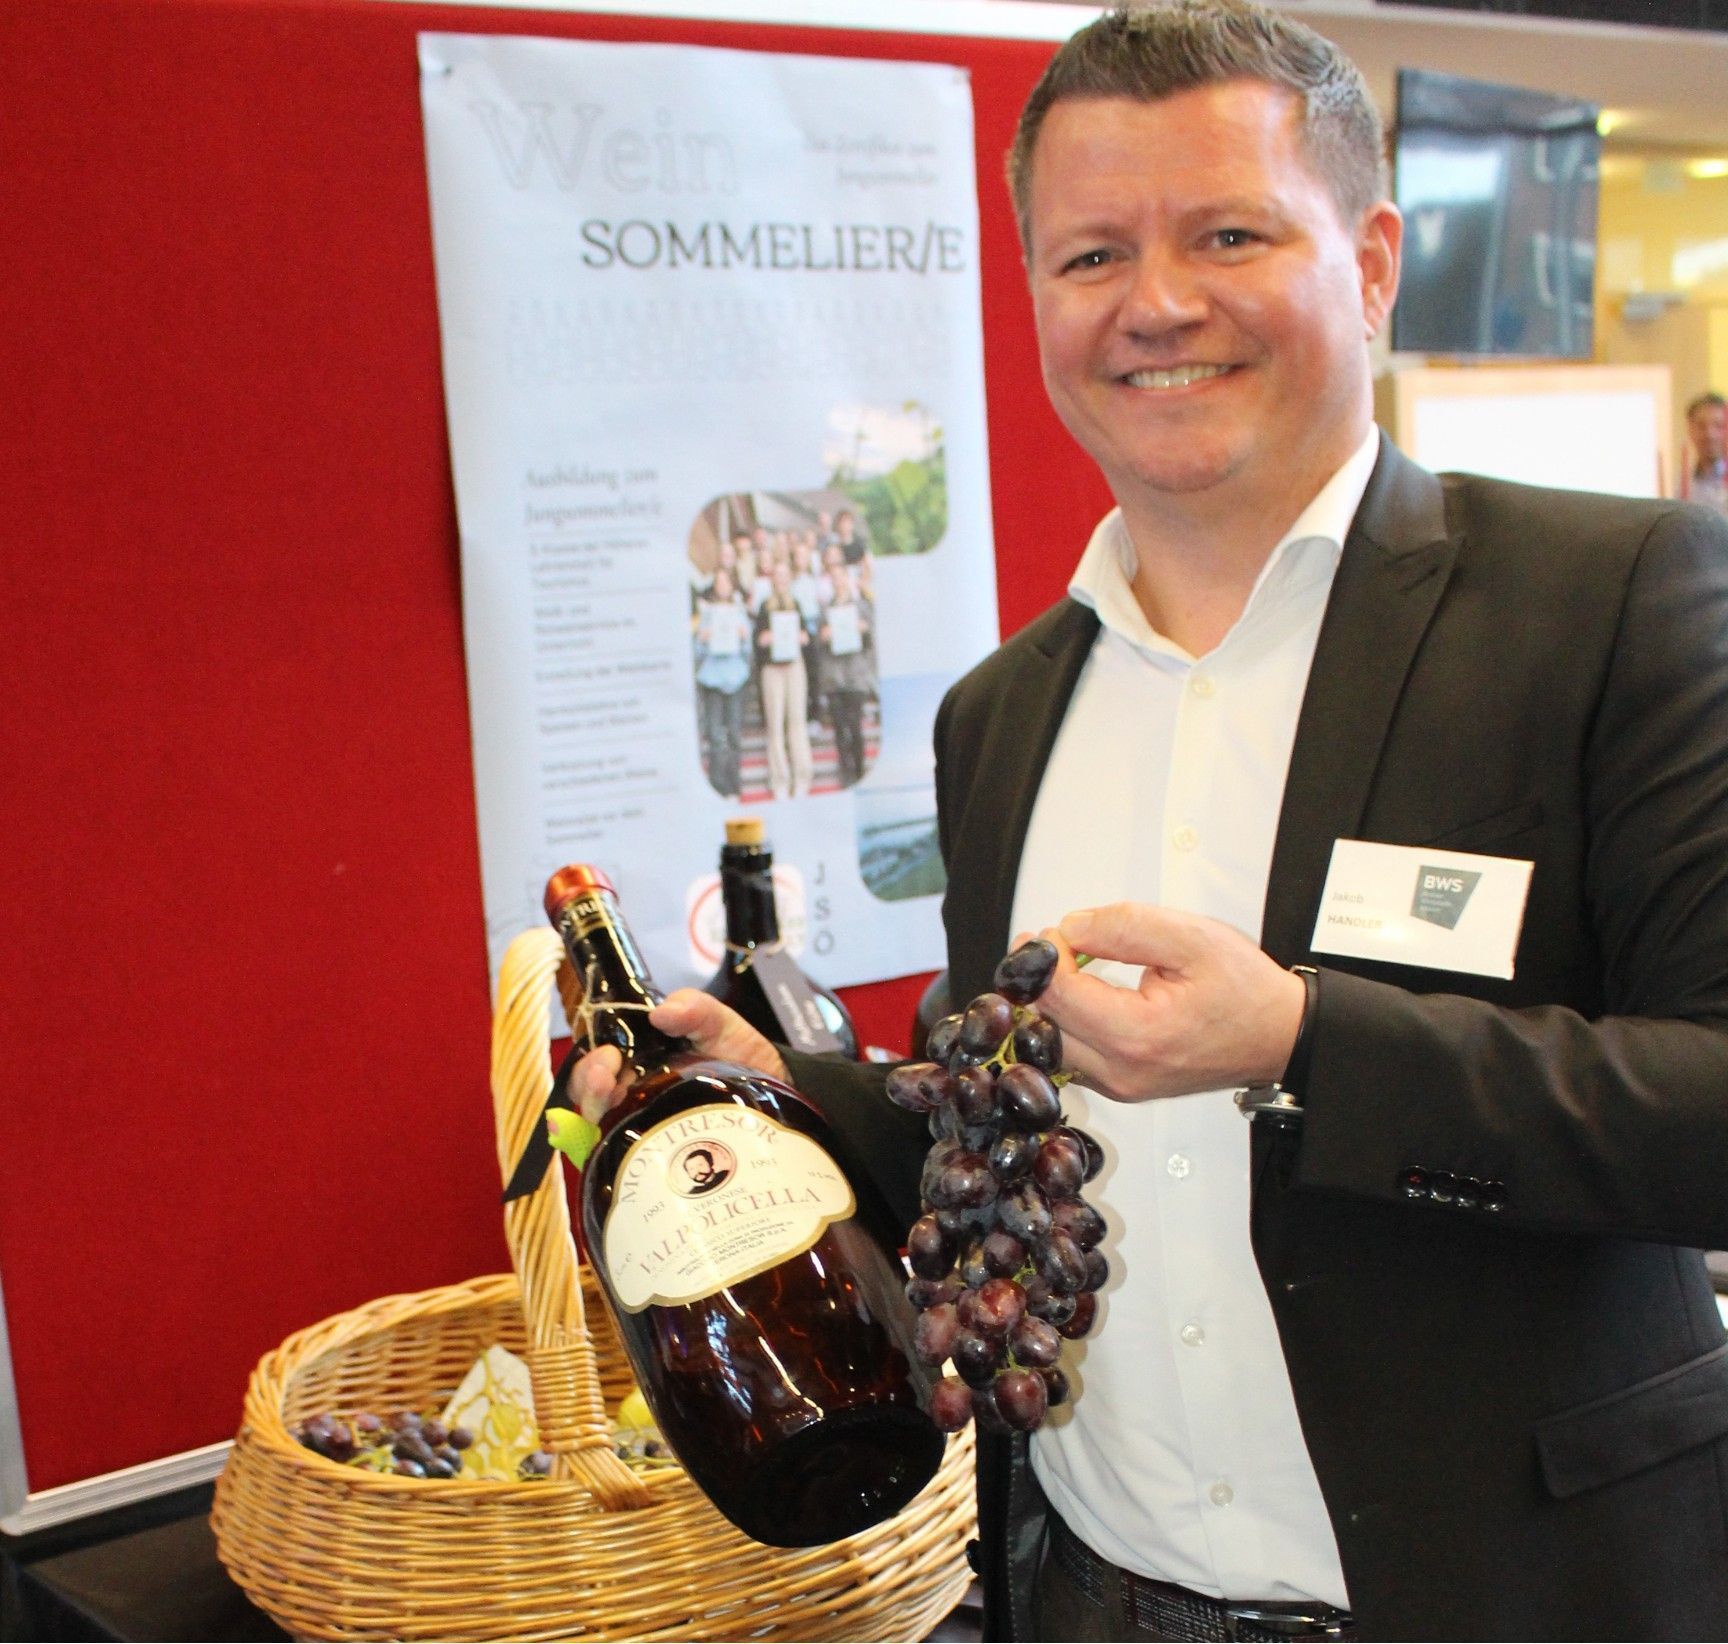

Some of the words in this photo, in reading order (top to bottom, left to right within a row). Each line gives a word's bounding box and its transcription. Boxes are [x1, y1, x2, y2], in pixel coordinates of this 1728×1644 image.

[470, 102, 741, 195] Wein
[581, 218, 966, 275] SOMMELIER/E
[1331, 891, 1364, 904] Jakob
[1423, 874, 1465, 893] BWS
[1327, 914, 1383, 929] HANDLER
[621, 1112, 779, 1203] MONTRESOR
[640, 1187, 822, 1275] VALPOLICELLA
